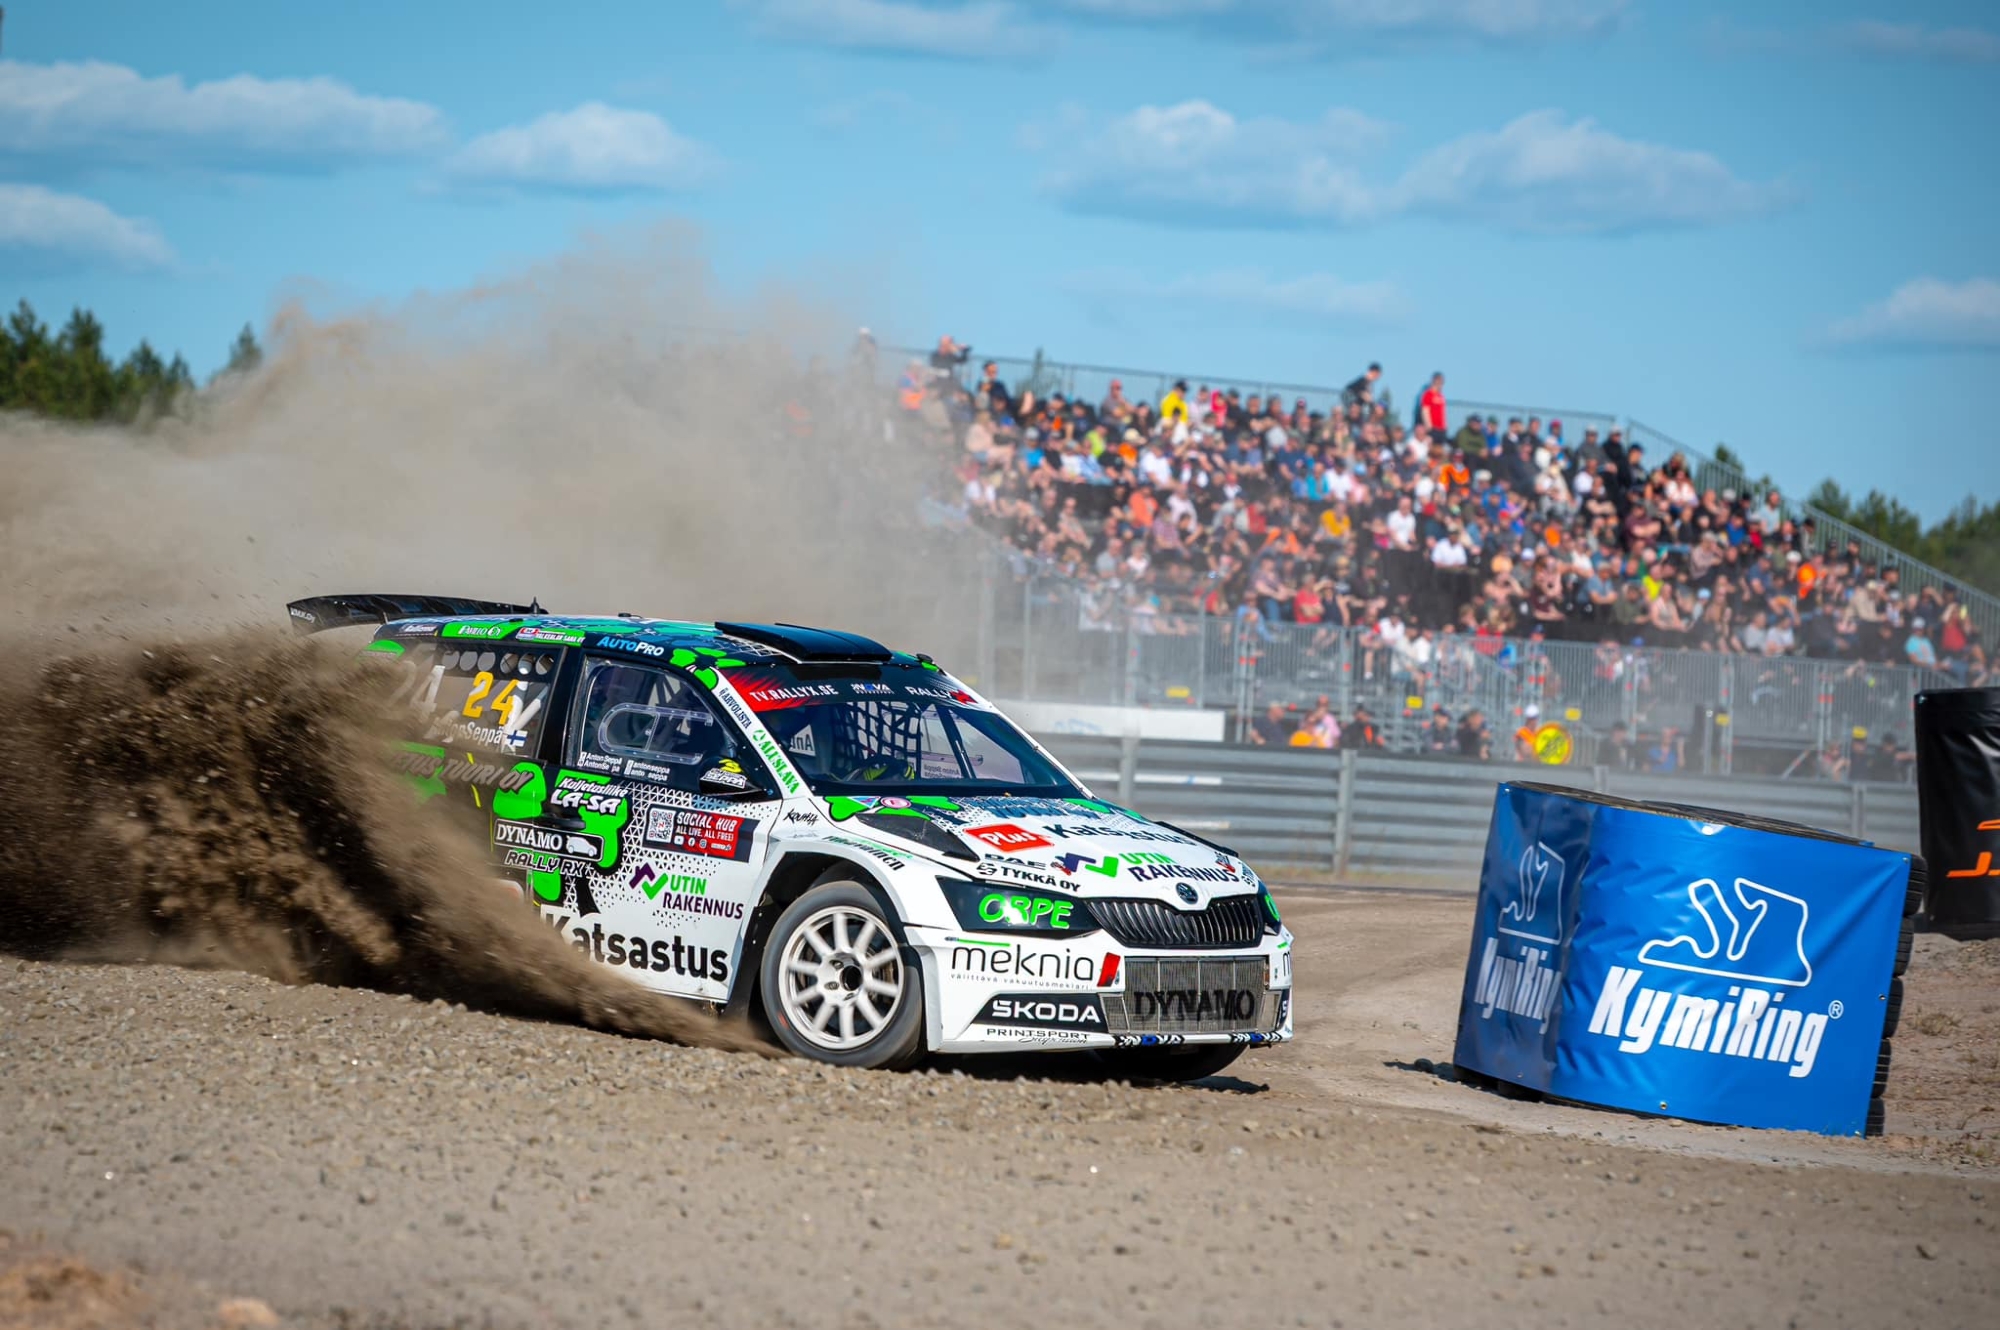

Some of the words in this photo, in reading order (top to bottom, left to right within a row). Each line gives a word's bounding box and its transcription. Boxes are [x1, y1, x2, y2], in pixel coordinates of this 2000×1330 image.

[462, 671, 519, 726] 24
[750, 684, 839, 702] TV.RALLYX.SE
[758, 738, 801, 796] ALUSLAVA
[551, 789, 621, 814] LA-SA
[675, 825, 687, 834] ALL
[704, 830, 716, 840] ALL
[676, 812, 712, 828] SOCIAL
[716, 818, 738, 832] HUB
[496, 824, 563, 851] DYNAMO
[504, 850, 560, 873] RALLY
[560, 858, 586, 878] RX
[1128, 864, 1241, 883] RAKENNUS
[670, 876, 708, 896] UTIN
[1001, 866, 1057, 887] TYKKÄ
[1060, 880, 1081, 892] OY
[662, 892, 744, 920] RAKENNUS
[543, 912, 728, 984] Katsastus
[952, 944, 1094, 981] meknia
[1474, 937, 1562, 1035] KymiRing
[1133, 990, 1256, 1022] DYNAMO
[987, 1028, 1090, 1040] PRINTSPORT
